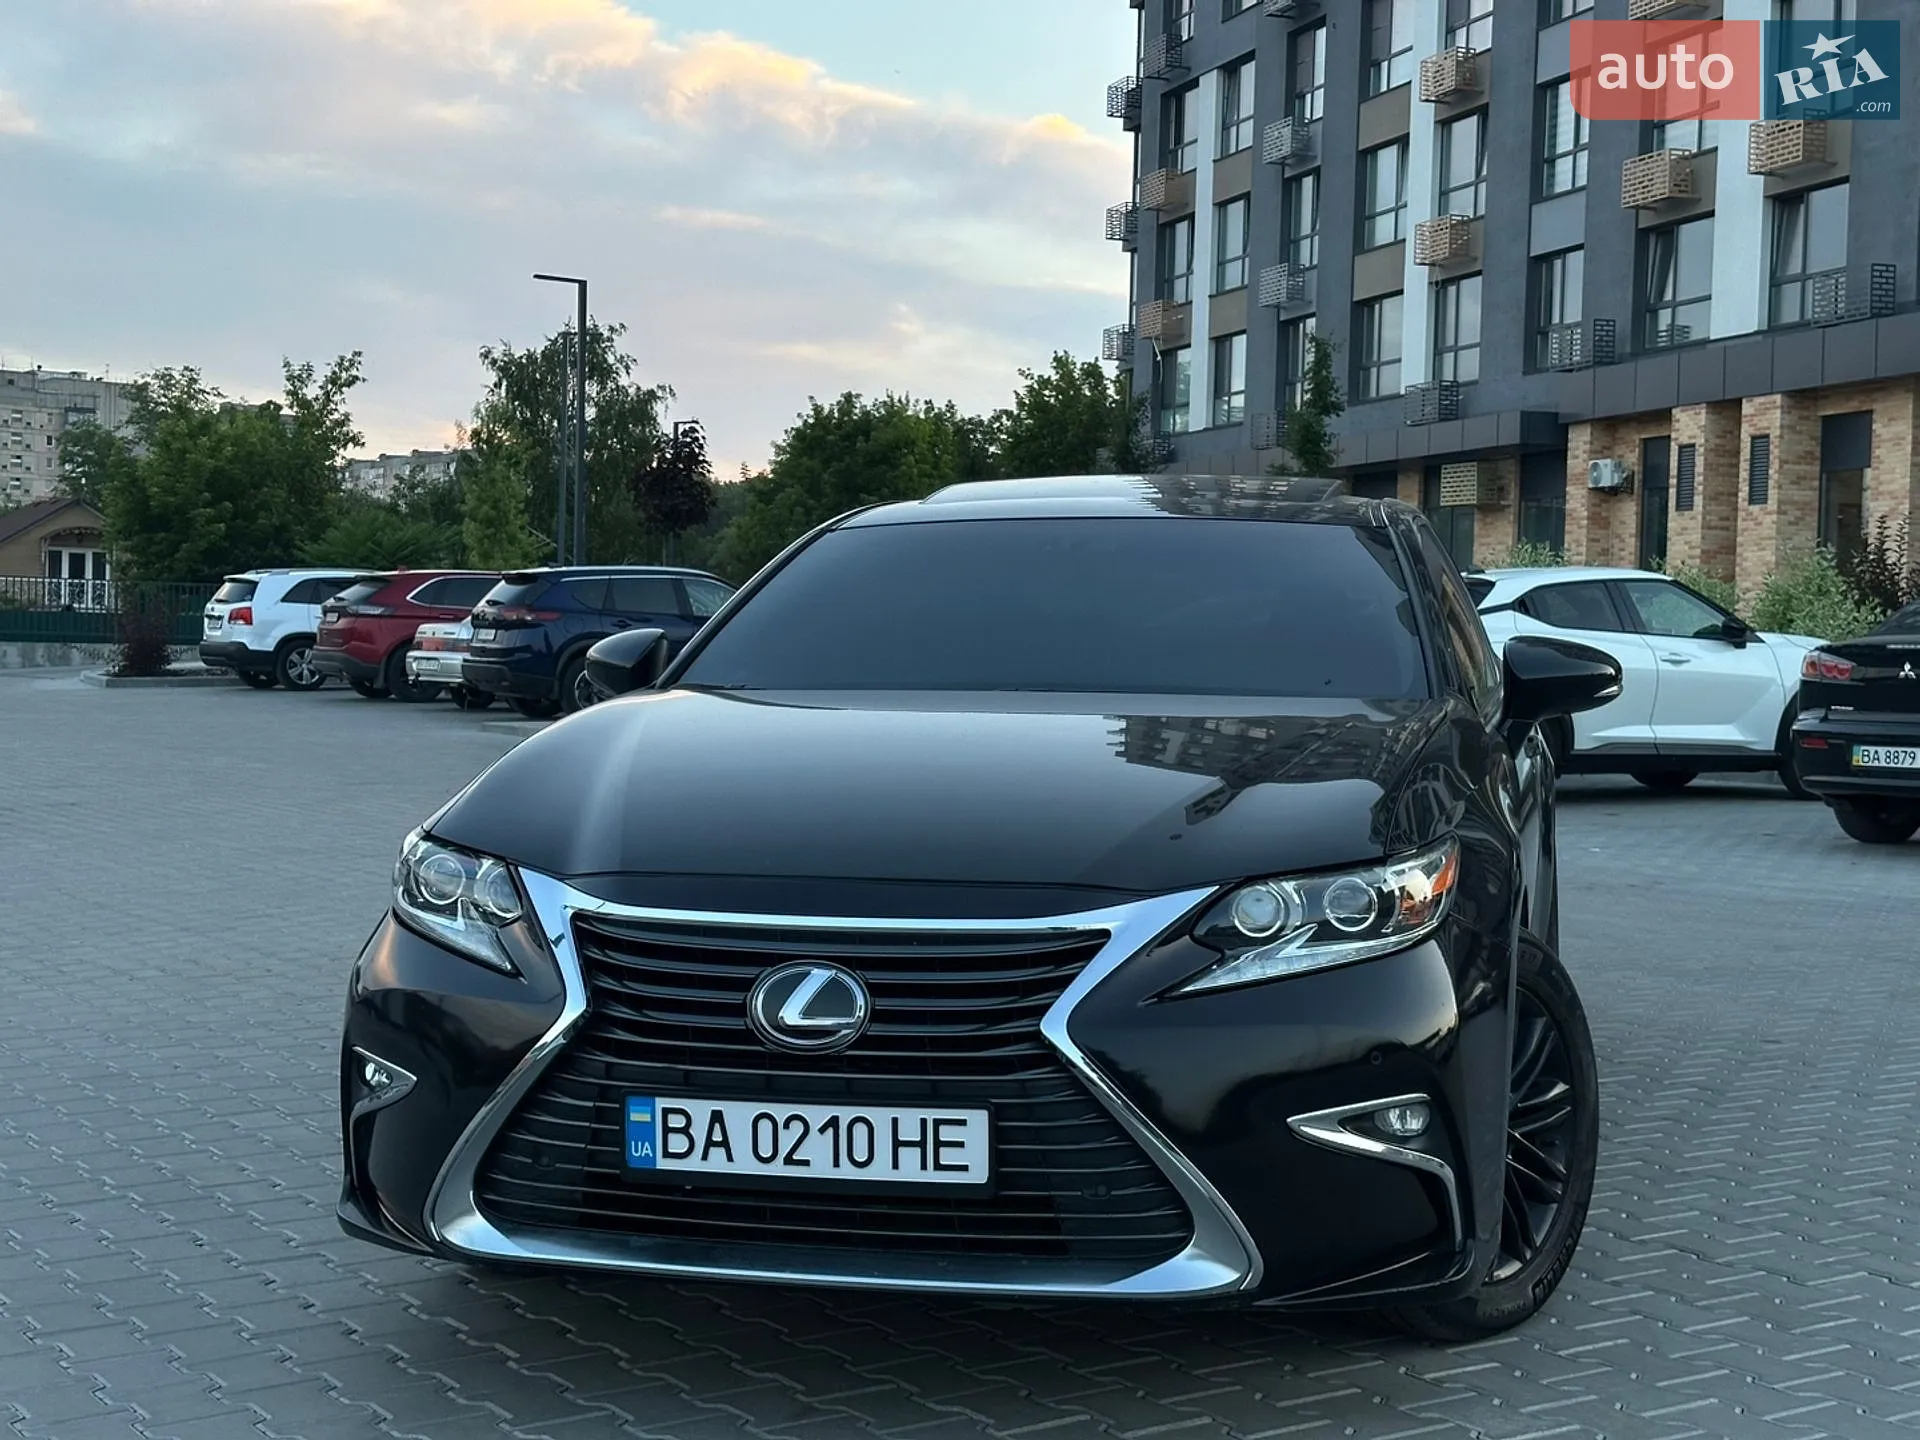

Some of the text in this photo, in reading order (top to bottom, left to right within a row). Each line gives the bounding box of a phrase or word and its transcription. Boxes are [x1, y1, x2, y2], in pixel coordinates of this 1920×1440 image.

[1861, 749, 1916, 766] BA 8879
[661, 1106, 969, 1172] BA 0210 HE
[631, 1141, 653, 1157] UA
